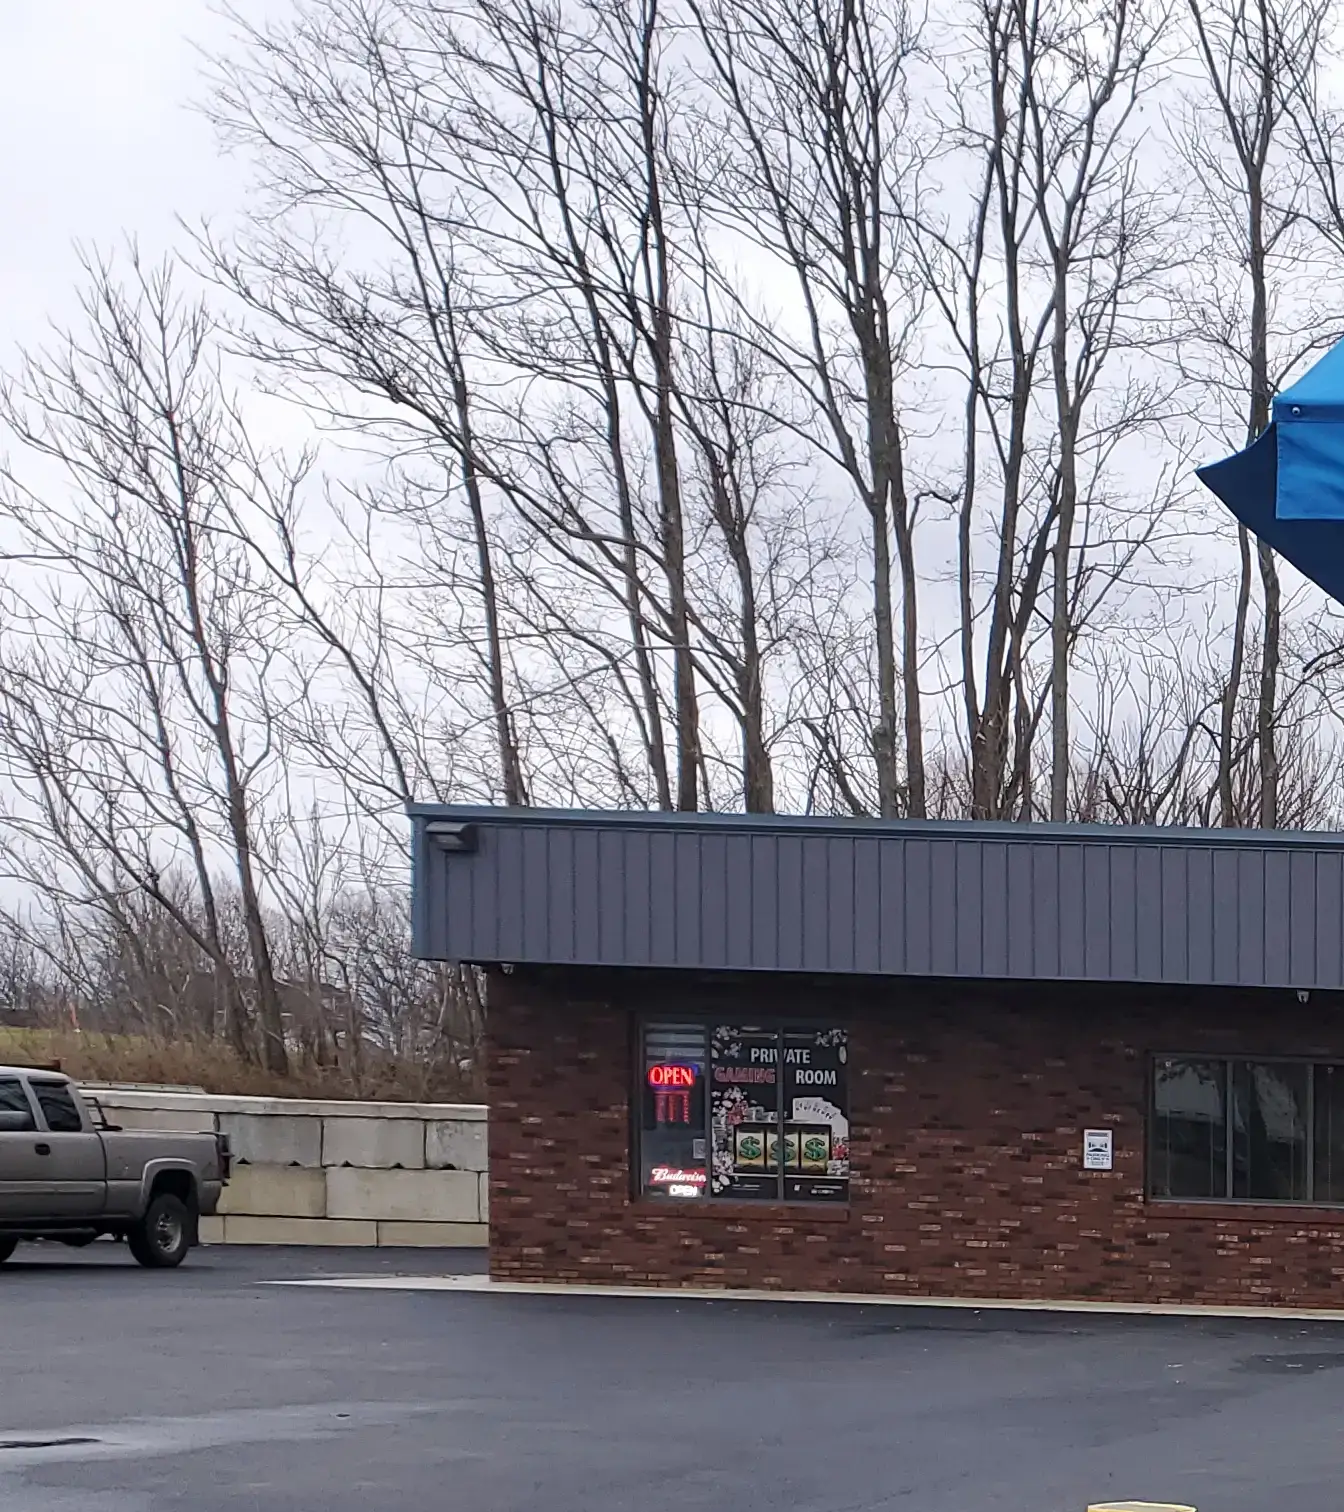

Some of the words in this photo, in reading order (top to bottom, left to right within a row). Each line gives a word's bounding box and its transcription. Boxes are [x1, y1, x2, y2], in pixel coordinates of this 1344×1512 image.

[751, 1048, 810, 1064] PRIVATE
[650, 1067, 693, 1085] OPEN
[714, 1067, 775, 1084] GAMING
[795, 1070, 836, 1085] ROOM
